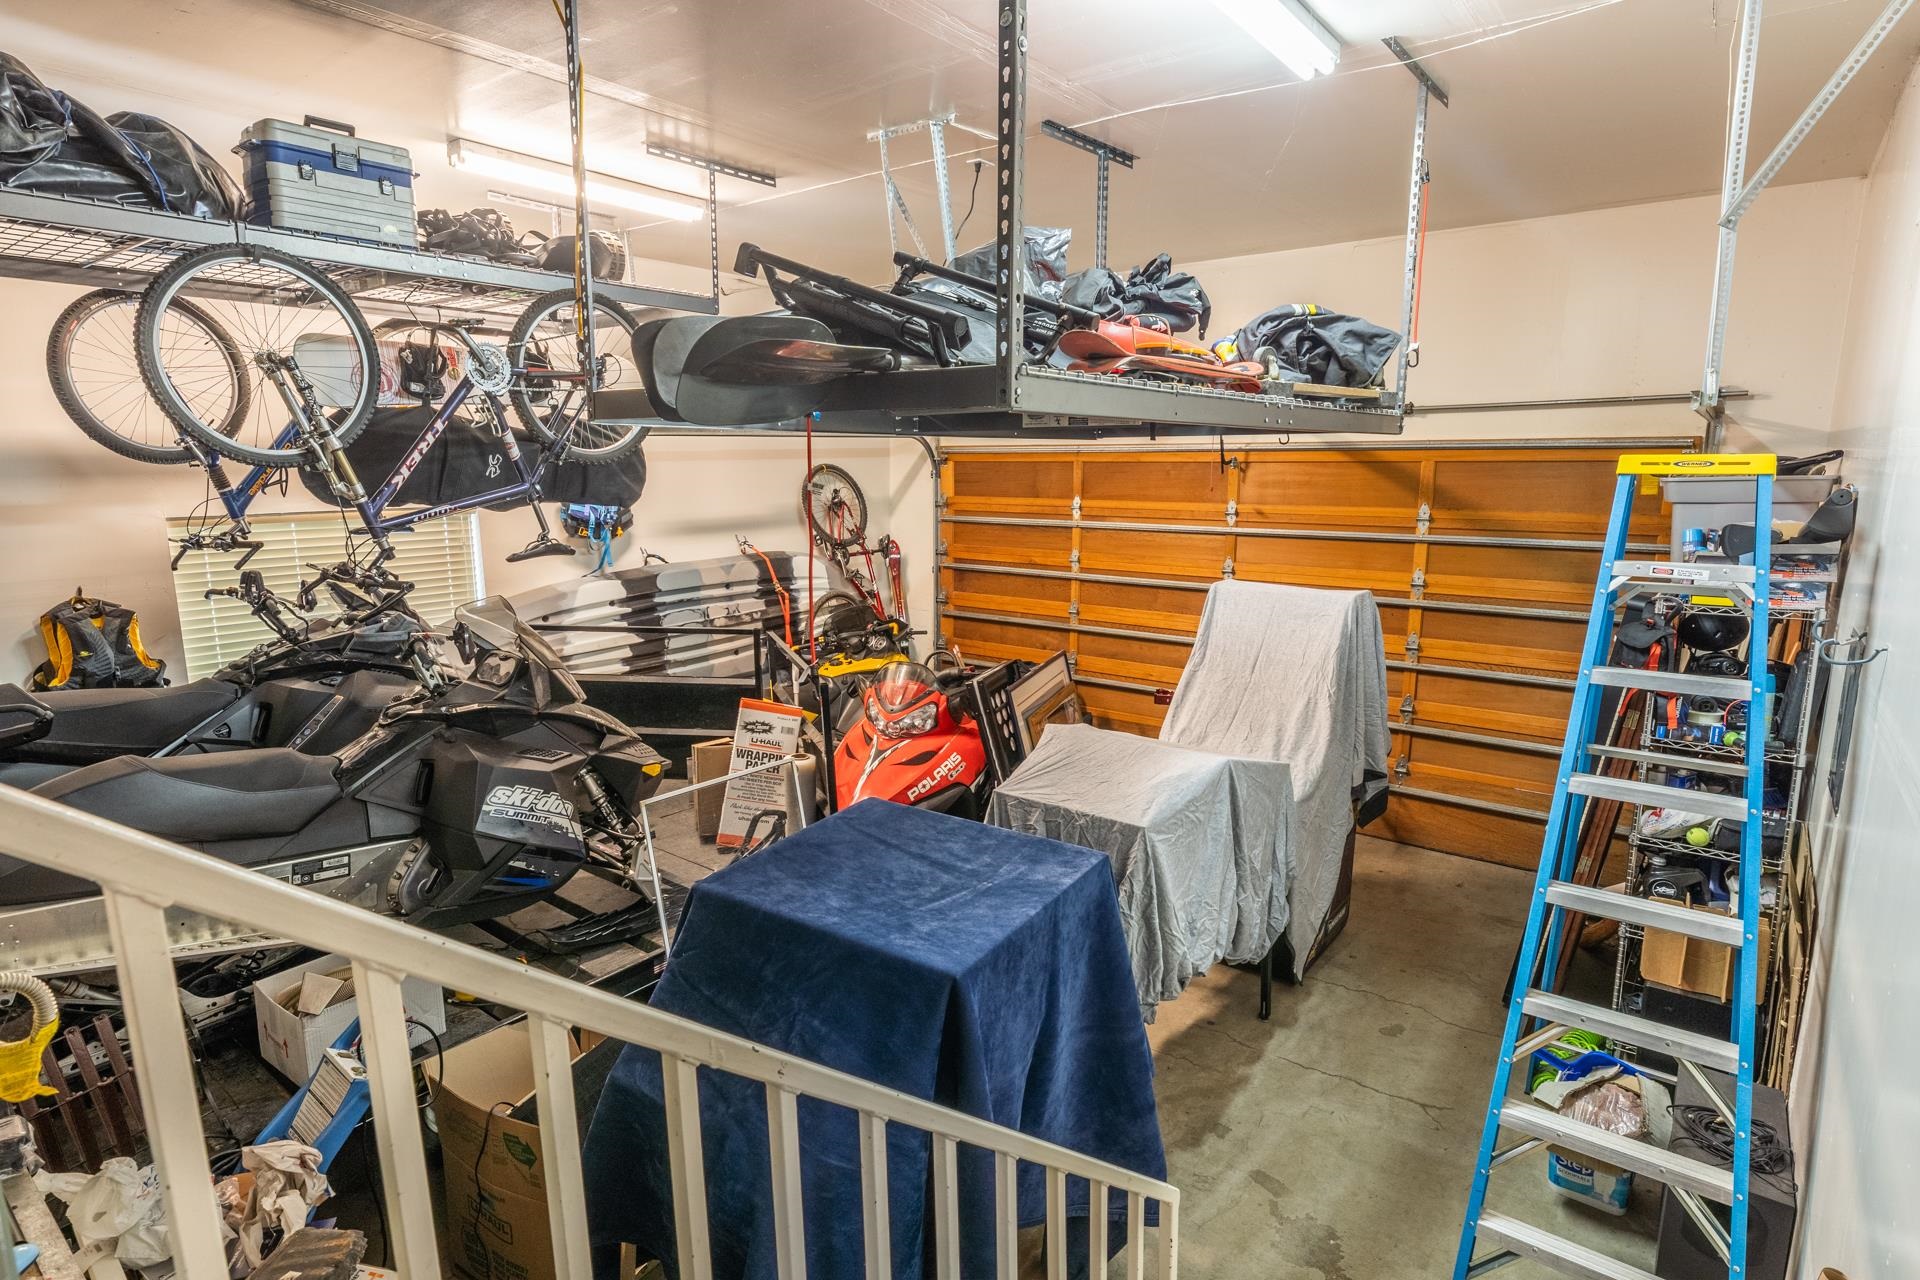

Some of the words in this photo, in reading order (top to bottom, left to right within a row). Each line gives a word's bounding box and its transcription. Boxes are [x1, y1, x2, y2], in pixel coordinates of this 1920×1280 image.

[391, 419, 448, 491] TREK
[736, 747, 788, 763] WRAPPIN
[751, 737, 783, 747] U-HAUL
[907, 752, 962, 801] POLARIS
[491, 808, 550, 825] SUMMIT
[470, 1198, 509, 1236] UHAUL
